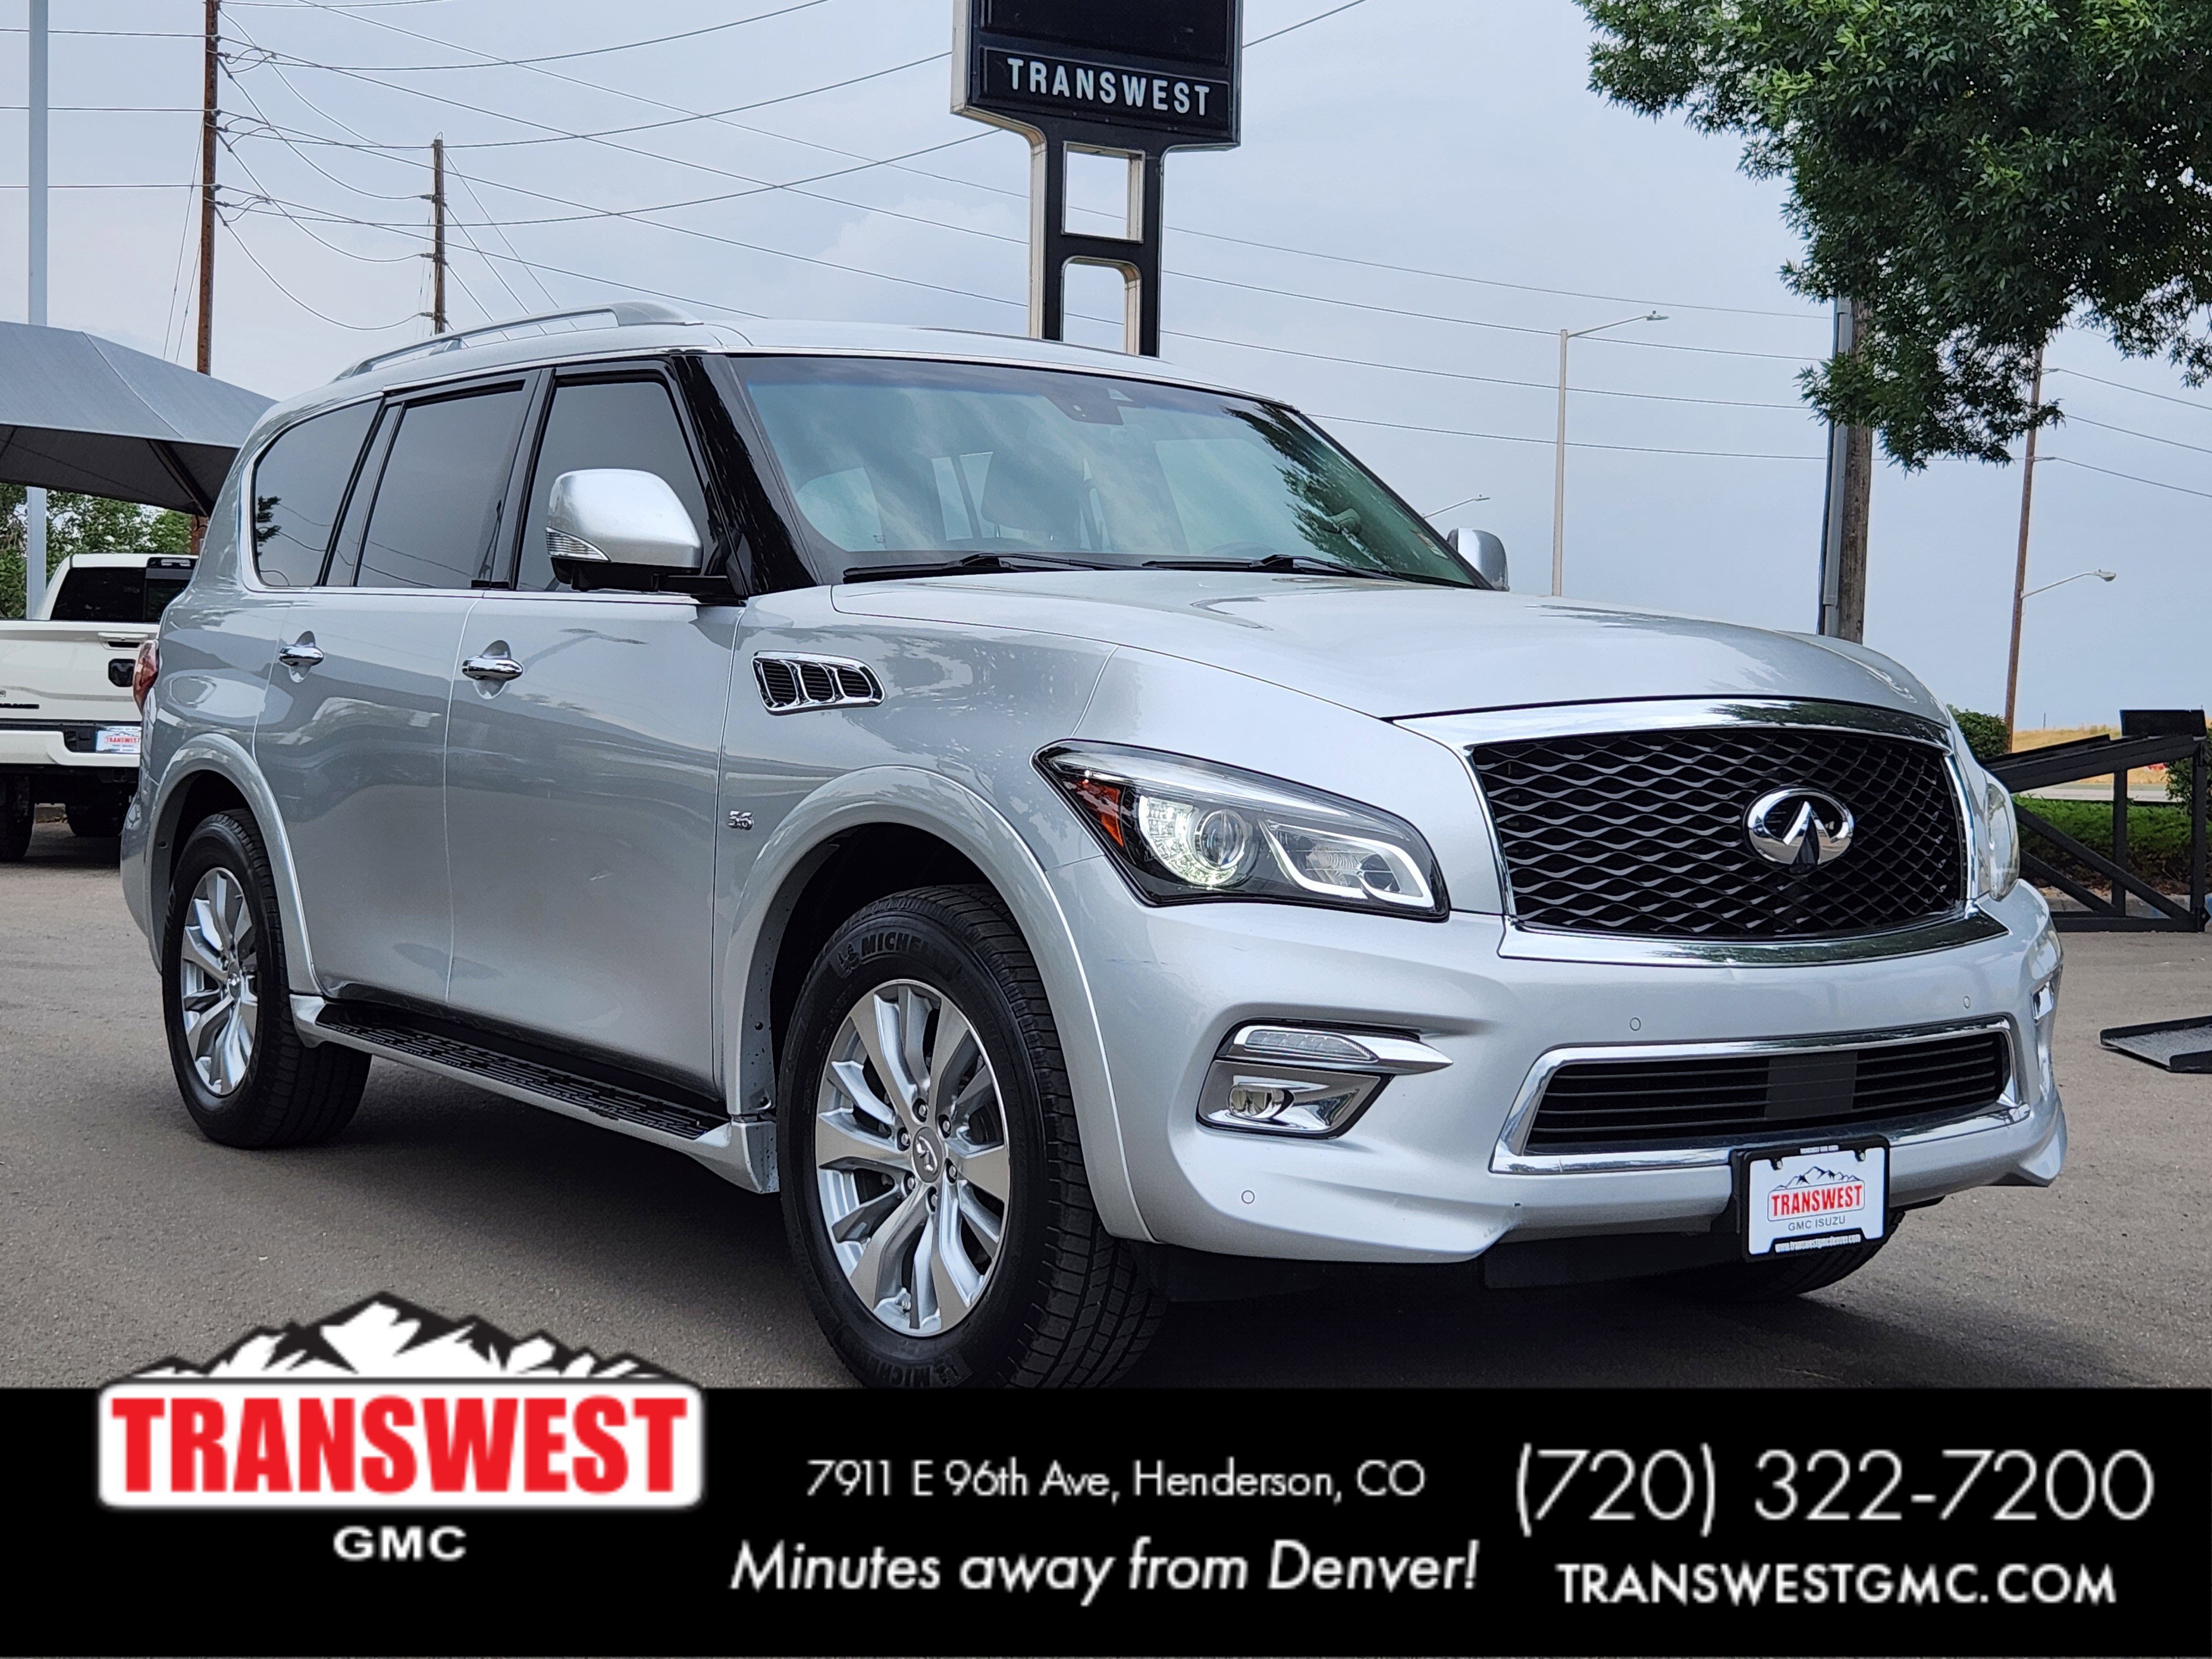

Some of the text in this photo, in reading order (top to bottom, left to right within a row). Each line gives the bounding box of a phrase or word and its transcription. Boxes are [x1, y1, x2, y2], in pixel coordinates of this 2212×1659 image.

[1006, 57, 1211, 116] TRANSWEST
[860, 931, 961, 982] MICHEL
[1771, 1184, 1863, 1217] TRANSWEST
[1788, 1215, 1846, 1232] GMC ISUZU
